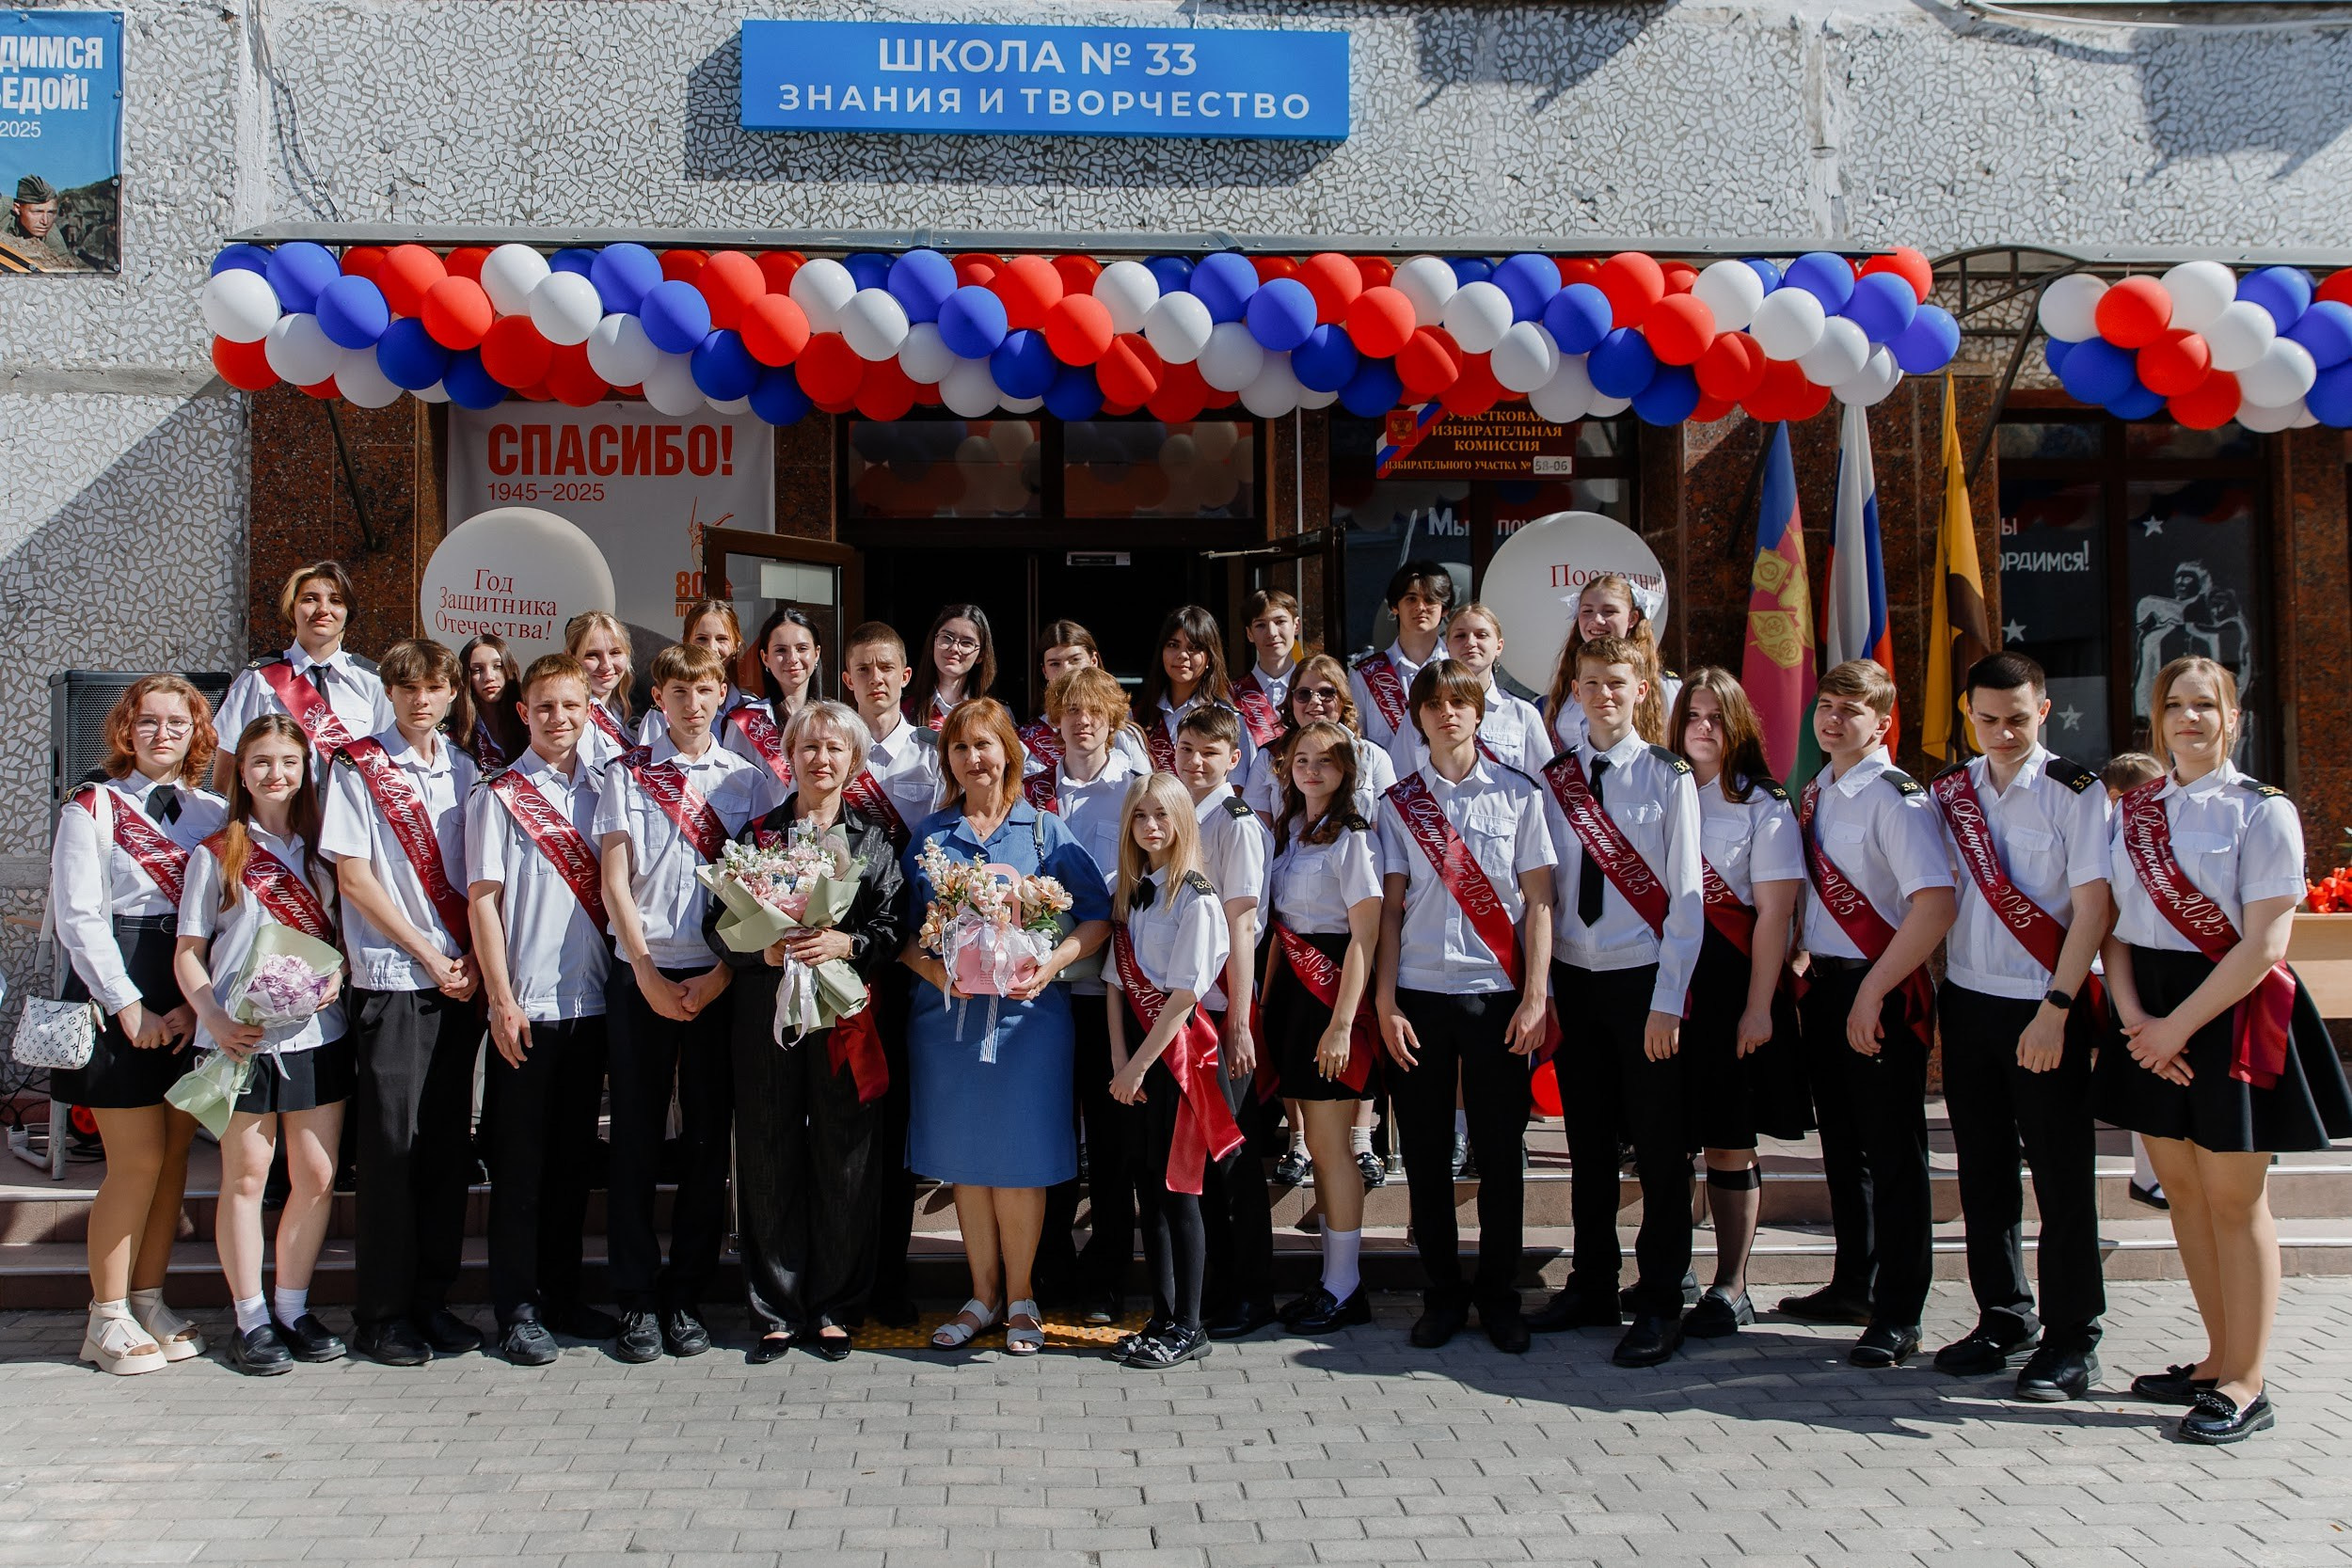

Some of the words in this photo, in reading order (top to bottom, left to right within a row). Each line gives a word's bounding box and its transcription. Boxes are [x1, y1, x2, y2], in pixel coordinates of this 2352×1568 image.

[879, 38, 1066, 72] ШКОЛА
[1082, 41, 1132, 75] №
[1145, 43, 1198, 76] 33
[0, 73, 88, 115] ЕДОЙ!
[778, 84, 961, 113] ЗНАНИЯ
[979, 88, 1004, 114] И
[1020, 88, 1311, 119] ТВОРЧЕСТВО
[1432, 426, 1563, 437] ИЗБИРАТЕЛЬНАЯ
[1454, 439, 1540, 451] КОМИССИЯ
[487, 423, 733, 477] СПАСИБО!
[1385, 460, 1472, 470] ИЗБИРАТЕЛЬНОГО
[1474, 460, 1518, 470] УЧАСТКА
[1520, 460, 1532, 469] №
[1427, 507, 1470, 537] Мы
[474, 569, 514, 595] Год
[438, 586, 558, 617] Защитника
[435, 610, 552, 641] Отечества!
[1673, 758, 1691, 773] 33
[1772, 787, 1788, 798] 33
[1900, 781, 1918, 792] 33
[2072, 774, 2092, 790] 33
[377, 773, 434, 862] Выпускник
[1232, 805, 1248, 815] 33
[1352, 820, 1366, 830] 33
[515, 793, 585, 871] Выпускник
[1563, 781, 1621, 859] Выпускник
[1609, 852, 1659, 895] 2025
[1406, 798, 1469, 878] Выпускник
[1456, 873, 1500, 916] 2025
[1950, 798, 1998, 888] Выпускник
[1989, 884, 2043, 929] 2025
[2130, 805, 2182, 900] Выпускница
[2169, 893, 2233, 937] 2025
[1296, 946, 1343, 986] 2025
